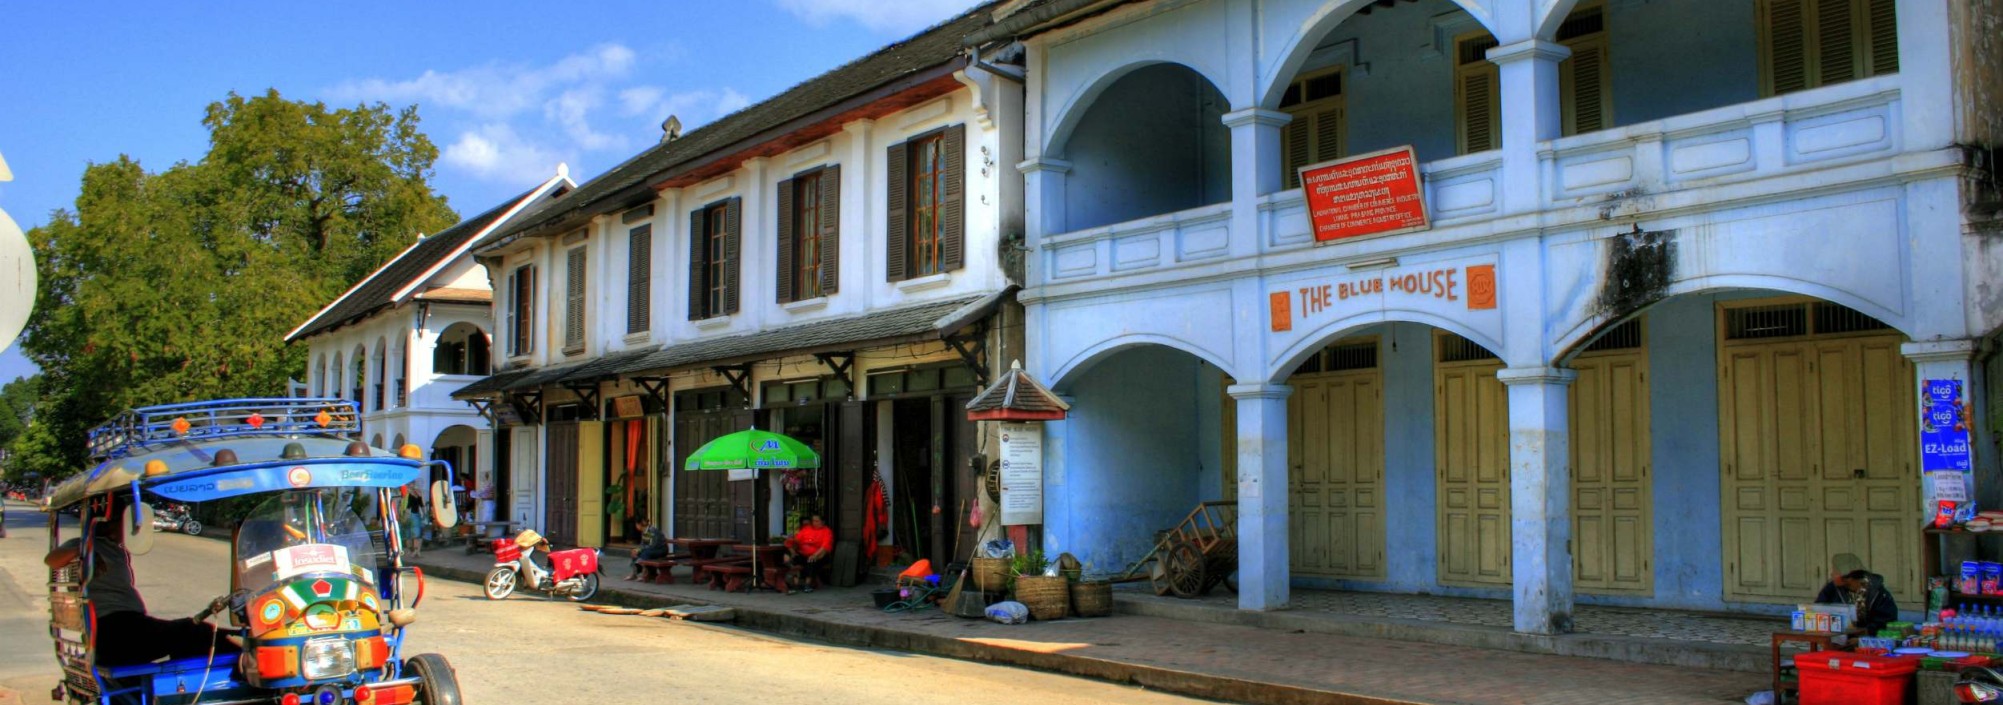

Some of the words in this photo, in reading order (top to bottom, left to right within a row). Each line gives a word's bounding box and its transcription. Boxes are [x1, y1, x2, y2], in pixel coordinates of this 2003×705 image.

[1299, 284, 1332, 318] THE
[1338, 278, 1383, 300] BLUE
[1390, 268, 1458, 301] HOUSE
[1925, 442, 1967, 454] EZ-Load
